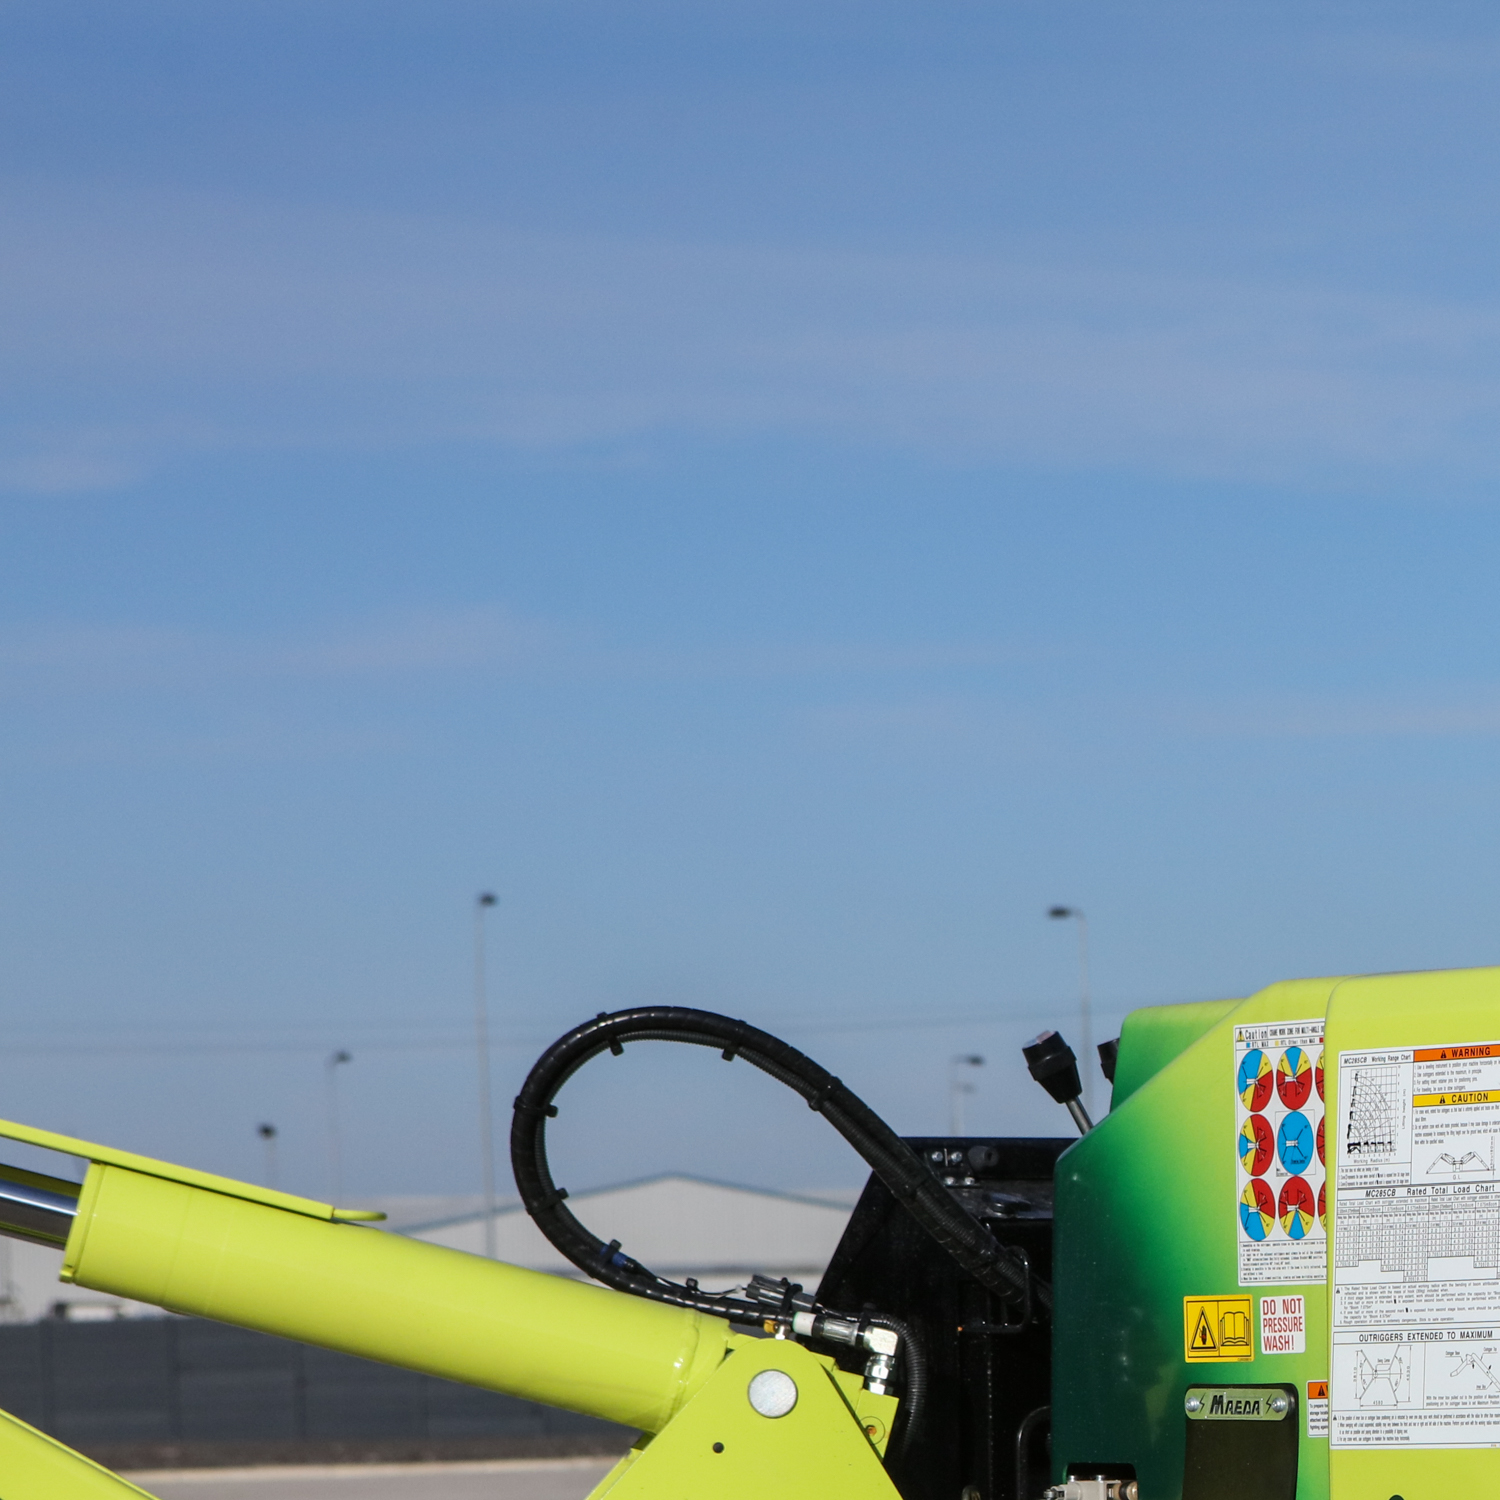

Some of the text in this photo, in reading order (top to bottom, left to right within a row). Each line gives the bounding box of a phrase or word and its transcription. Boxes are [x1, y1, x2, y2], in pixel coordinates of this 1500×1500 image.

[1244, 1028, 1267, 1039] Caution
[1371, 1055, 1386, 1063] Working
[1387, 1054, 1399, 1062] Range
[1452, 1047, 1491, 1058] WARNING
[1452, 1092, 1489, 1103] CAUTION
[1364, 1183, 1494, 1198] MC285CB Rated Total Load Chart
[1262, 1297, 1302, 1315] DO NOT
[1263, 1316, 1304, 1333] PRESSURE
[1263, 1334, 1295, 1352] WASH!
[1358, 1329, 1492, 1343] OUTRIGGERS EXTENDED TO MAXIMUM
[1210, 1394, 1260, 1416] MAEDA
